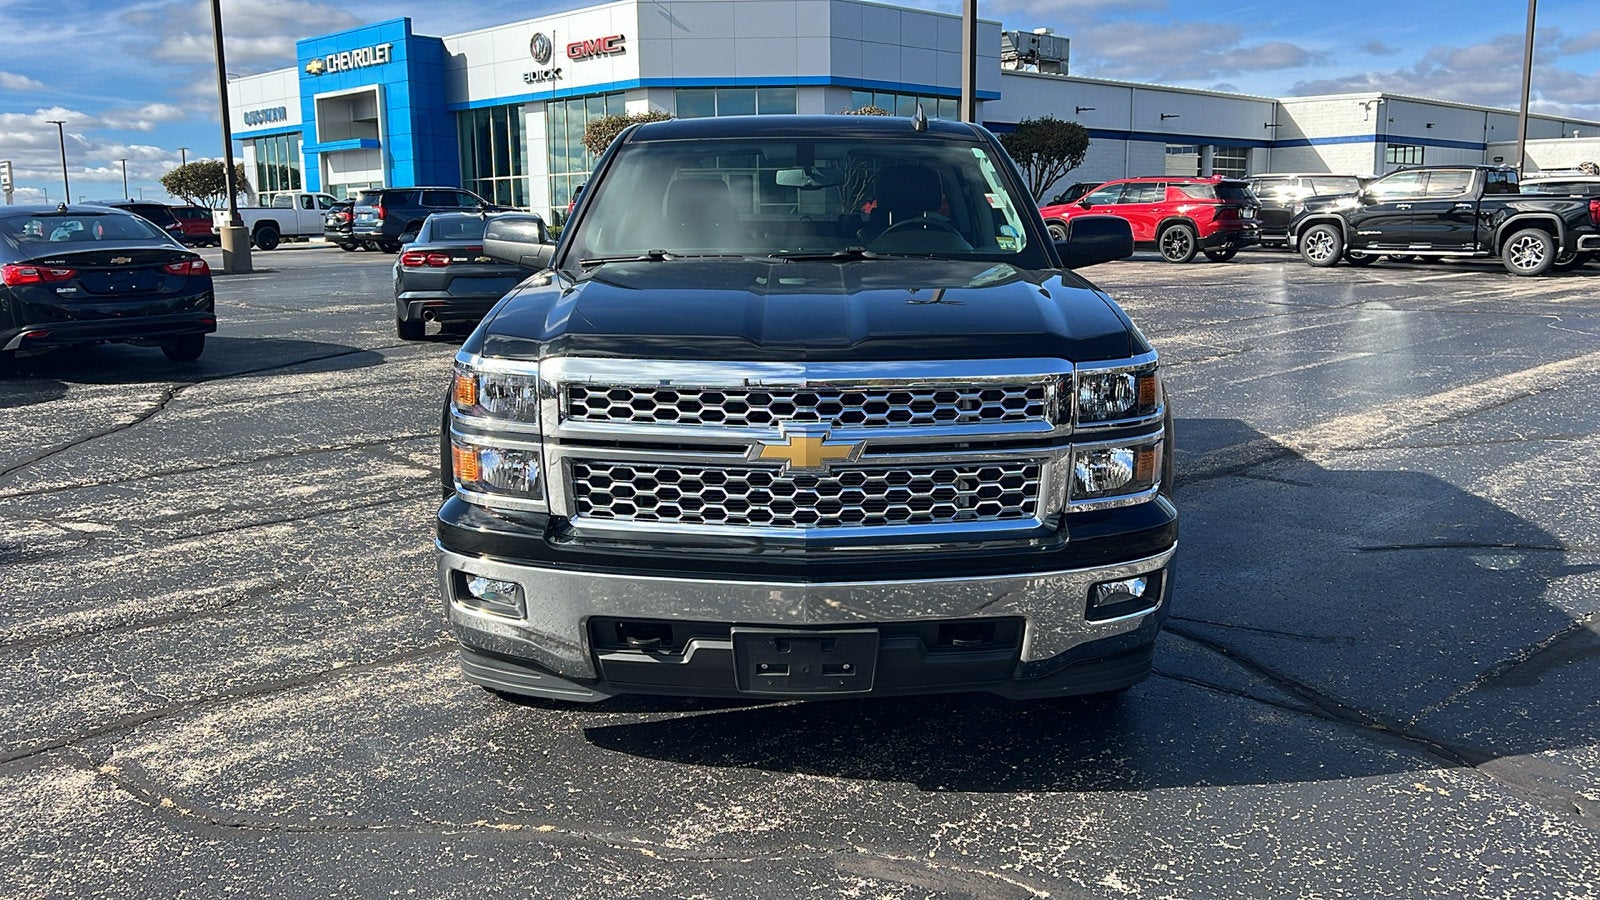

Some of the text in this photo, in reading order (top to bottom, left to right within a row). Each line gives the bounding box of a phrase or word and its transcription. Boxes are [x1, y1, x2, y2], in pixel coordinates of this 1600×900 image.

[326, 43, 393, 73] CHEVROLET
[566, 34, 625, 60] GMC
[523, 67, 562, 83] BUICK
